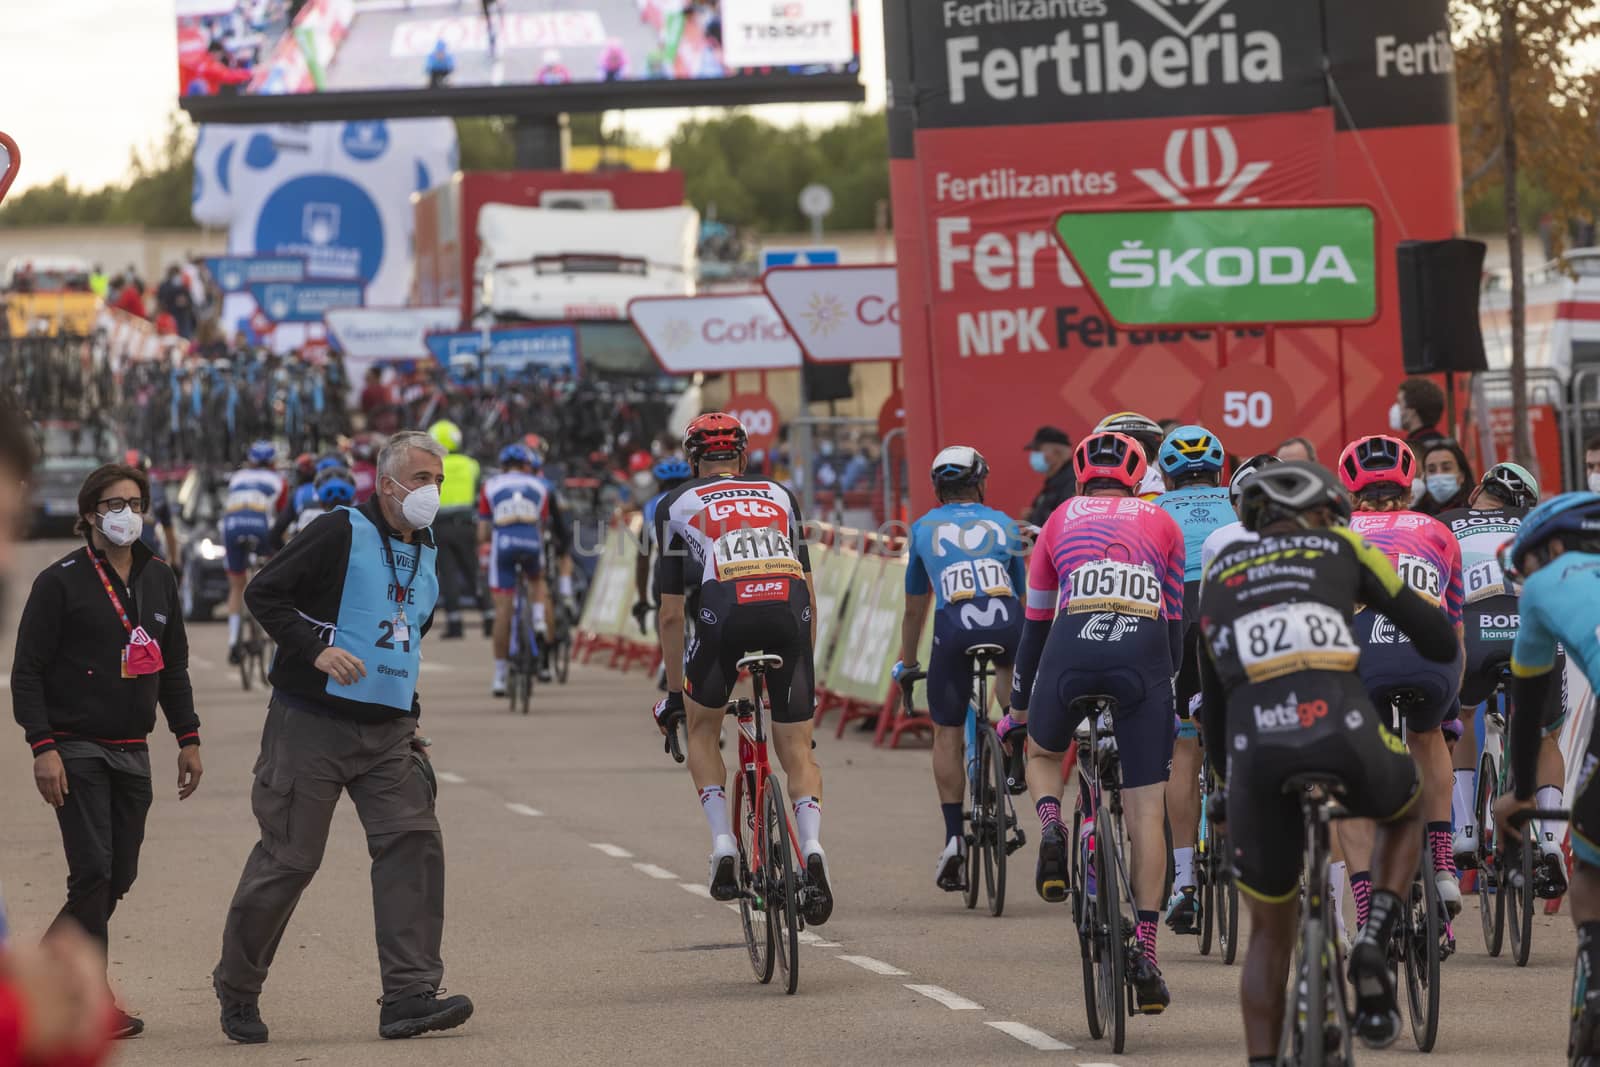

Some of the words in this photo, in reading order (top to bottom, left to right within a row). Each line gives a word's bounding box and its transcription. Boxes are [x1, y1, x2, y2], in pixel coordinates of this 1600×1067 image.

[943, 0, 1108, 28] Fertilizantes
[945, 14, 1284, 104] Fertiberia
[935, 168, 1118, 201] Fertilizantes
[1108, 240, 1357, 288] ŠKODA
[957, 307, 1050, 357] NPK
[729, 408, 772, 433] 100
[1223, 391, 1273, 428] 50
[701, 489, 774, 506] SOUDAL
[707, 500, 779, 522] Lotto
[1451, 517, 1520, 531] BORA
[744, 582, 784, 593] CAPS
[1071, 568, 1115, 597] 105
[1119, 569, 1160, 604] 105
[1400, 562, 1441, 597] 103
[1469, 564, 1492, 591] 61
[1249, 622, 1293, 657] 82
[1305, 614, 1350, 647] 82
